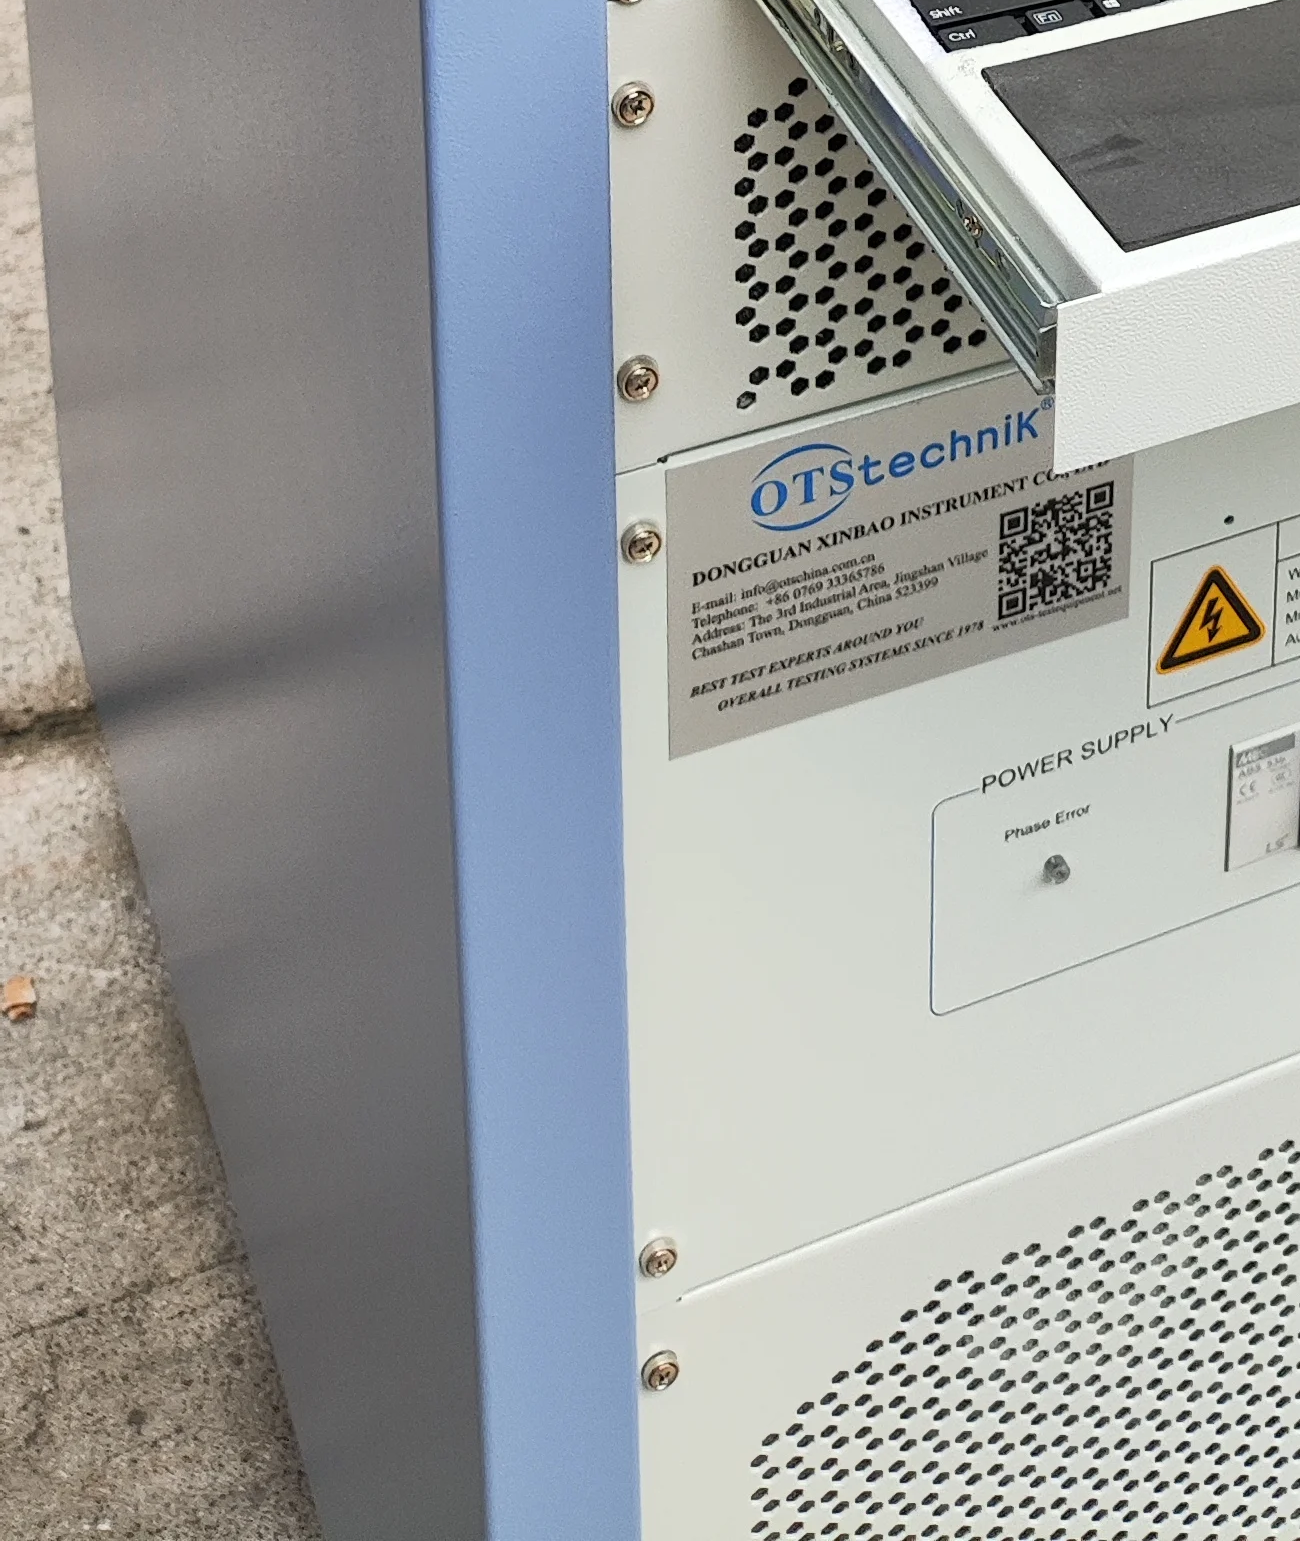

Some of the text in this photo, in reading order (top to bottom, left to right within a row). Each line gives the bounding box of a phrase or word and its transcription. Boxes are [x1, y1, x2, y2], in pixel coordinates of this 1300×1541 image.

[929, 5, 962, 20] Shift
[948, 29, 976, 42] Ctrl
[692, 540, 811, 587] DONGGUAN
[817, 516, 894, 551] XINBAO
[900, 475, 1028, 526] INSTRUMENT
[692, 592, 736, 615] E-mail:
[749, 613, 773, 628] The
[776, 605, 797, 620] 3rd
[799, 586, 856, 613] Industrial
[947, 549, 988, 567] Village
[766, 592, 790, 606] +86
[793, 581, 823, 600] 0769
[689, 617, 924, 699] BEST TEST EXPERTS AROUND YOU
[692, 637, 744, 660] Chashan
[857, 592, 892, 612] China
[717, 619, 984, 712] OVERALL TESTING SYSTEMS SINCE 1978
[981, 713, 1174, 794] POWER SUPPLY
[1004, 803, 1091, 842] Phase Error
